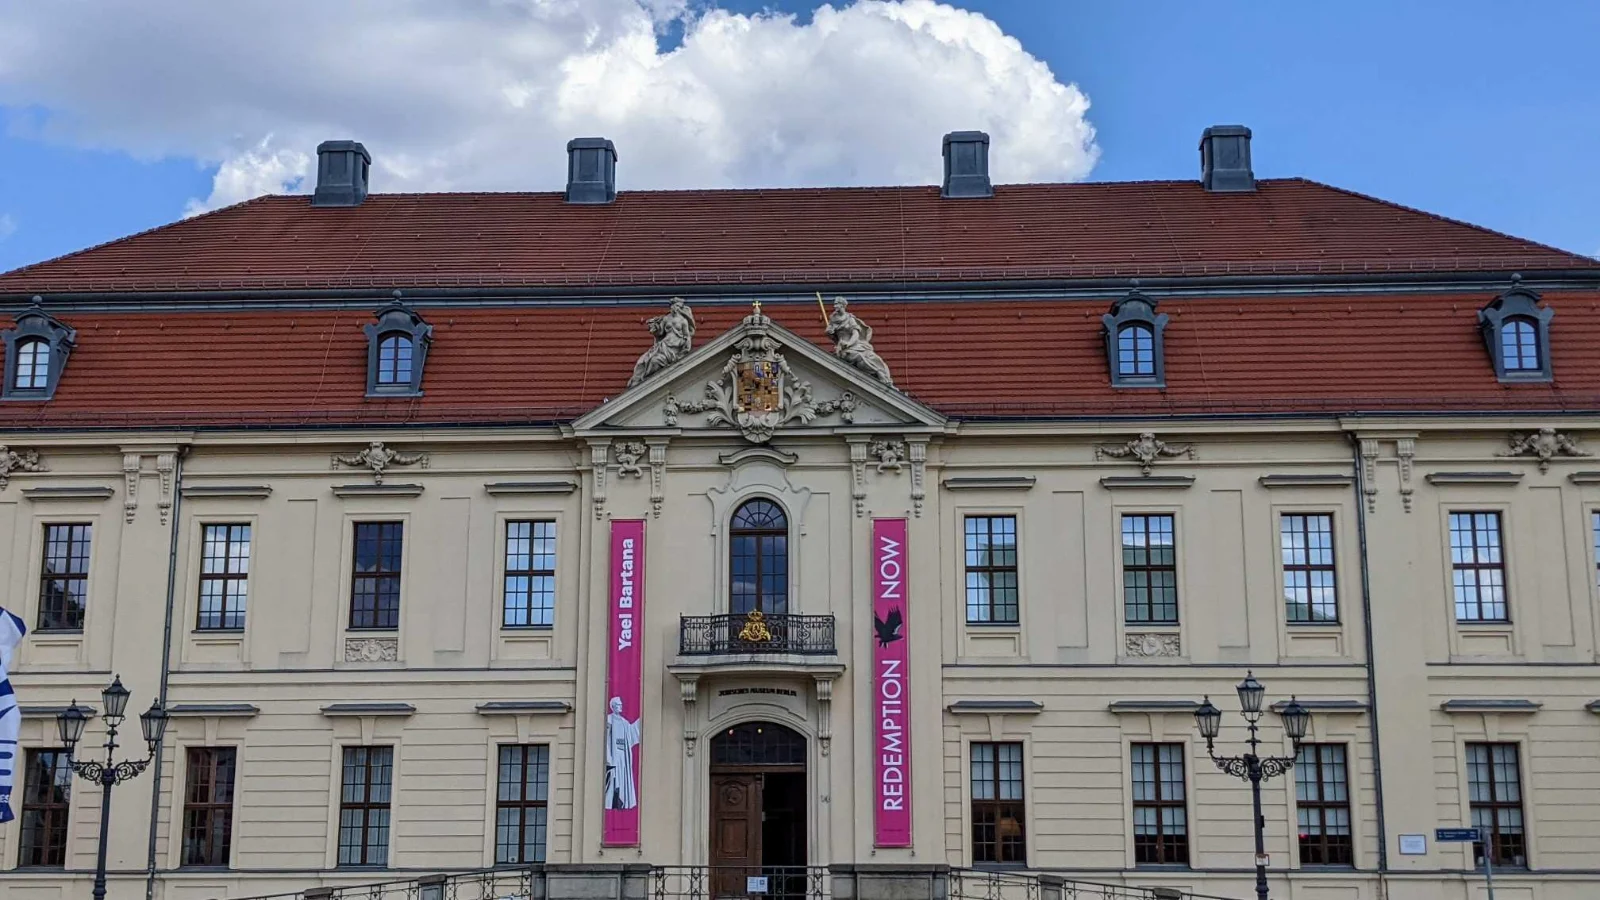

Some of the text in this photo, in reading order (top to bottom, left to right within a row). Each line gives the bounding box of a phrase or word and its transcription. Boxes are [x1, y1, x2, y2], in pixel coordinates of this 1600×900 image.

[618, 538, 634, 651] Yael Bartana
[880, 536, 901, 598] NOW
[881, 660, 903, 810] REDEMPTION
